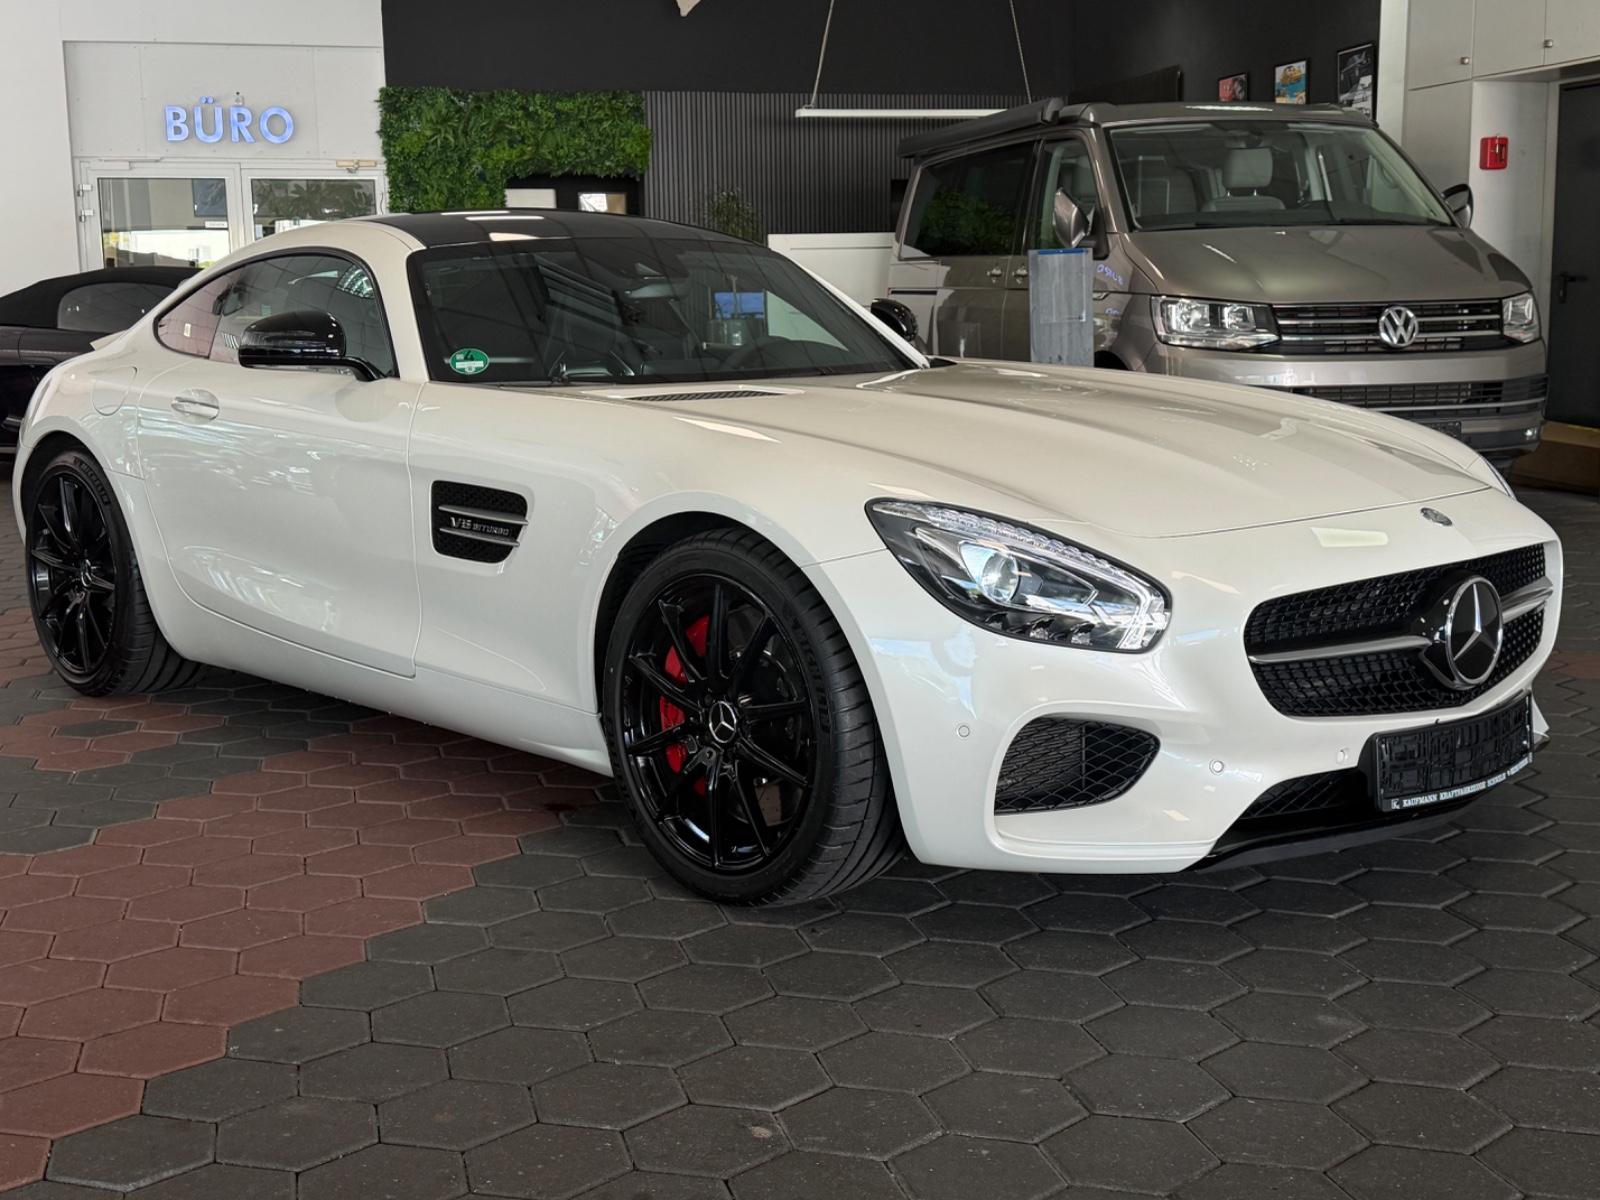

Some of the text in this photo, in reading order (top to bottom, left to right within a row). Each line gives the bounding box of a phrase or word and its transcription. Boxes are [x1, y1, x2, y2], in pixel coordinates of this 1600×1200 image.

[164, 95, 295, 144] BÜRO
[1380, 306, 1418, 347] VW
[463, 350, 475, 361] 4
[450, 516, 510, 536] V8 BITURBO
[1402, 793, 1438, 808] KAUFMANN
